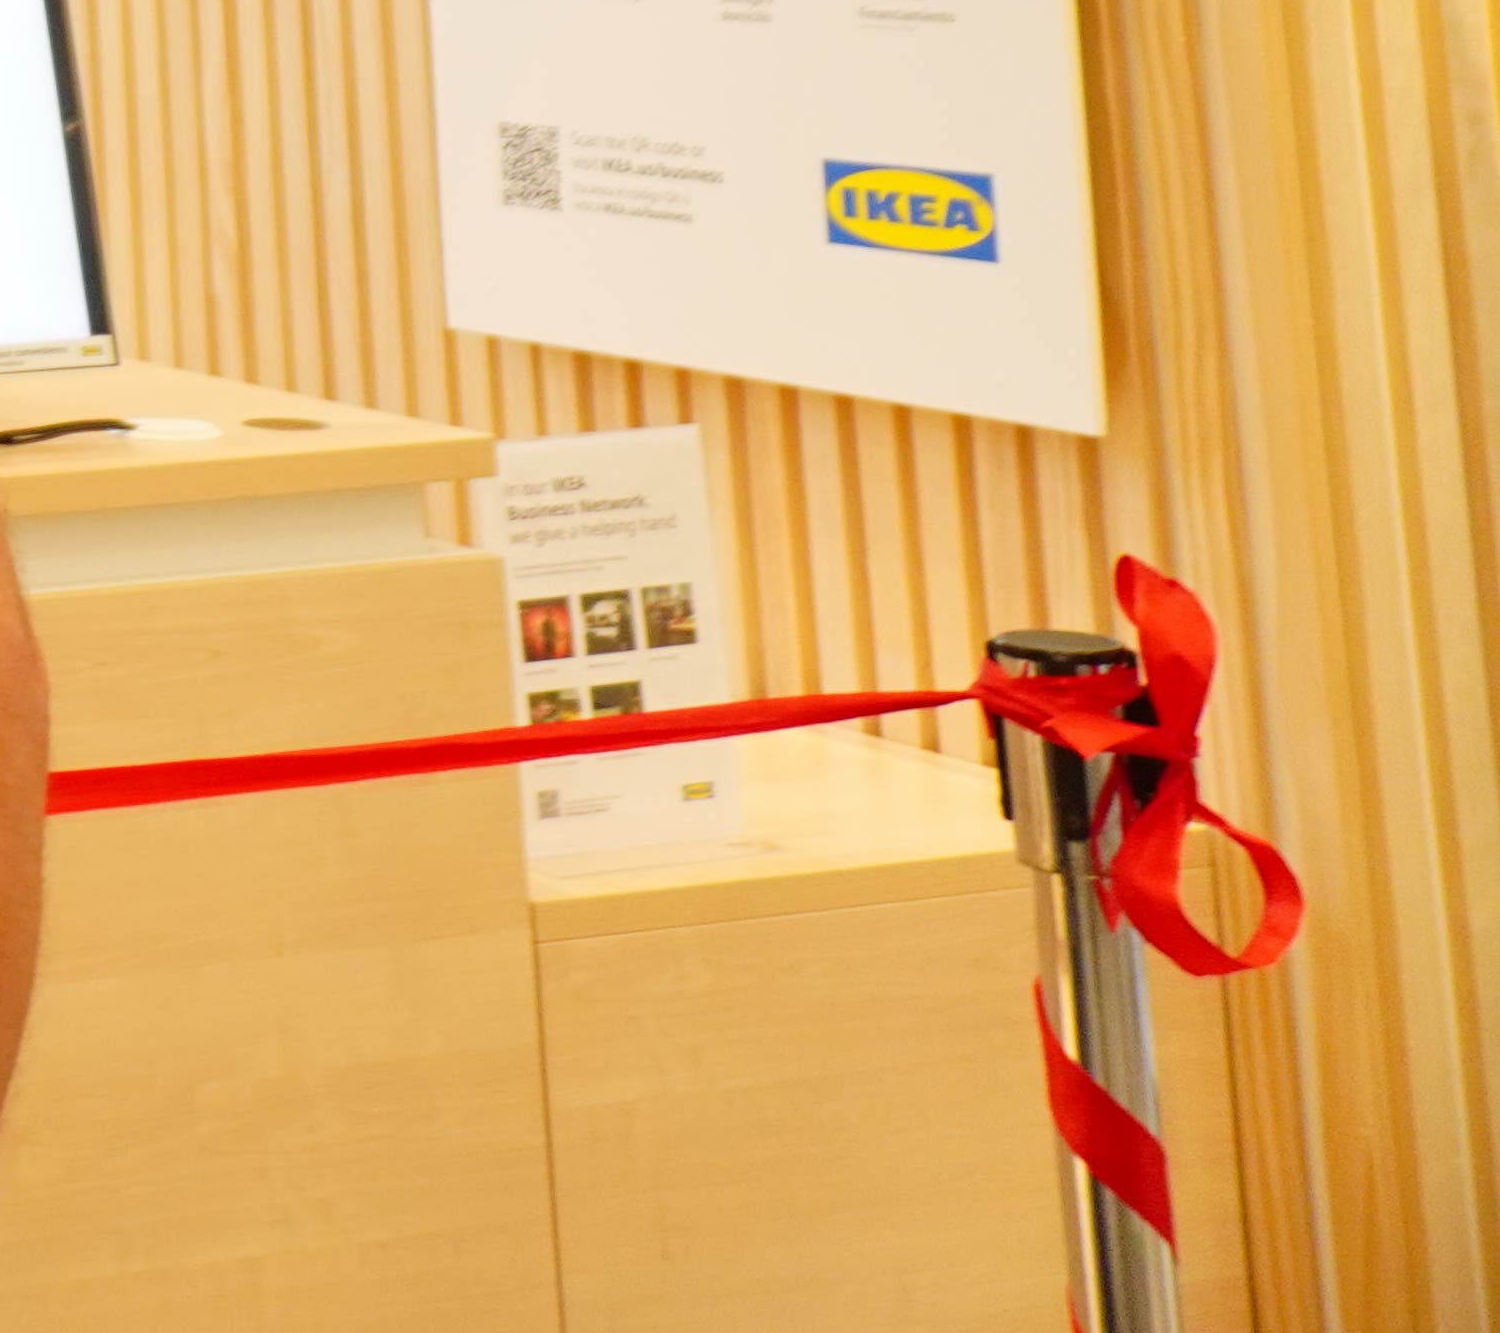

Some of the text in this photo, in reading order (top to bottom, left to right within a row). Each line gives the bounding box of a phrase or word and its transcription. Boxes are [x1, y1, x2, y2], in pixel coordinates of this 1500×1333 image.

[843, 188, 979, 231] IKEA
[552, 474, 587, 493] IKEA
[506, 501, 576, 522] Business
